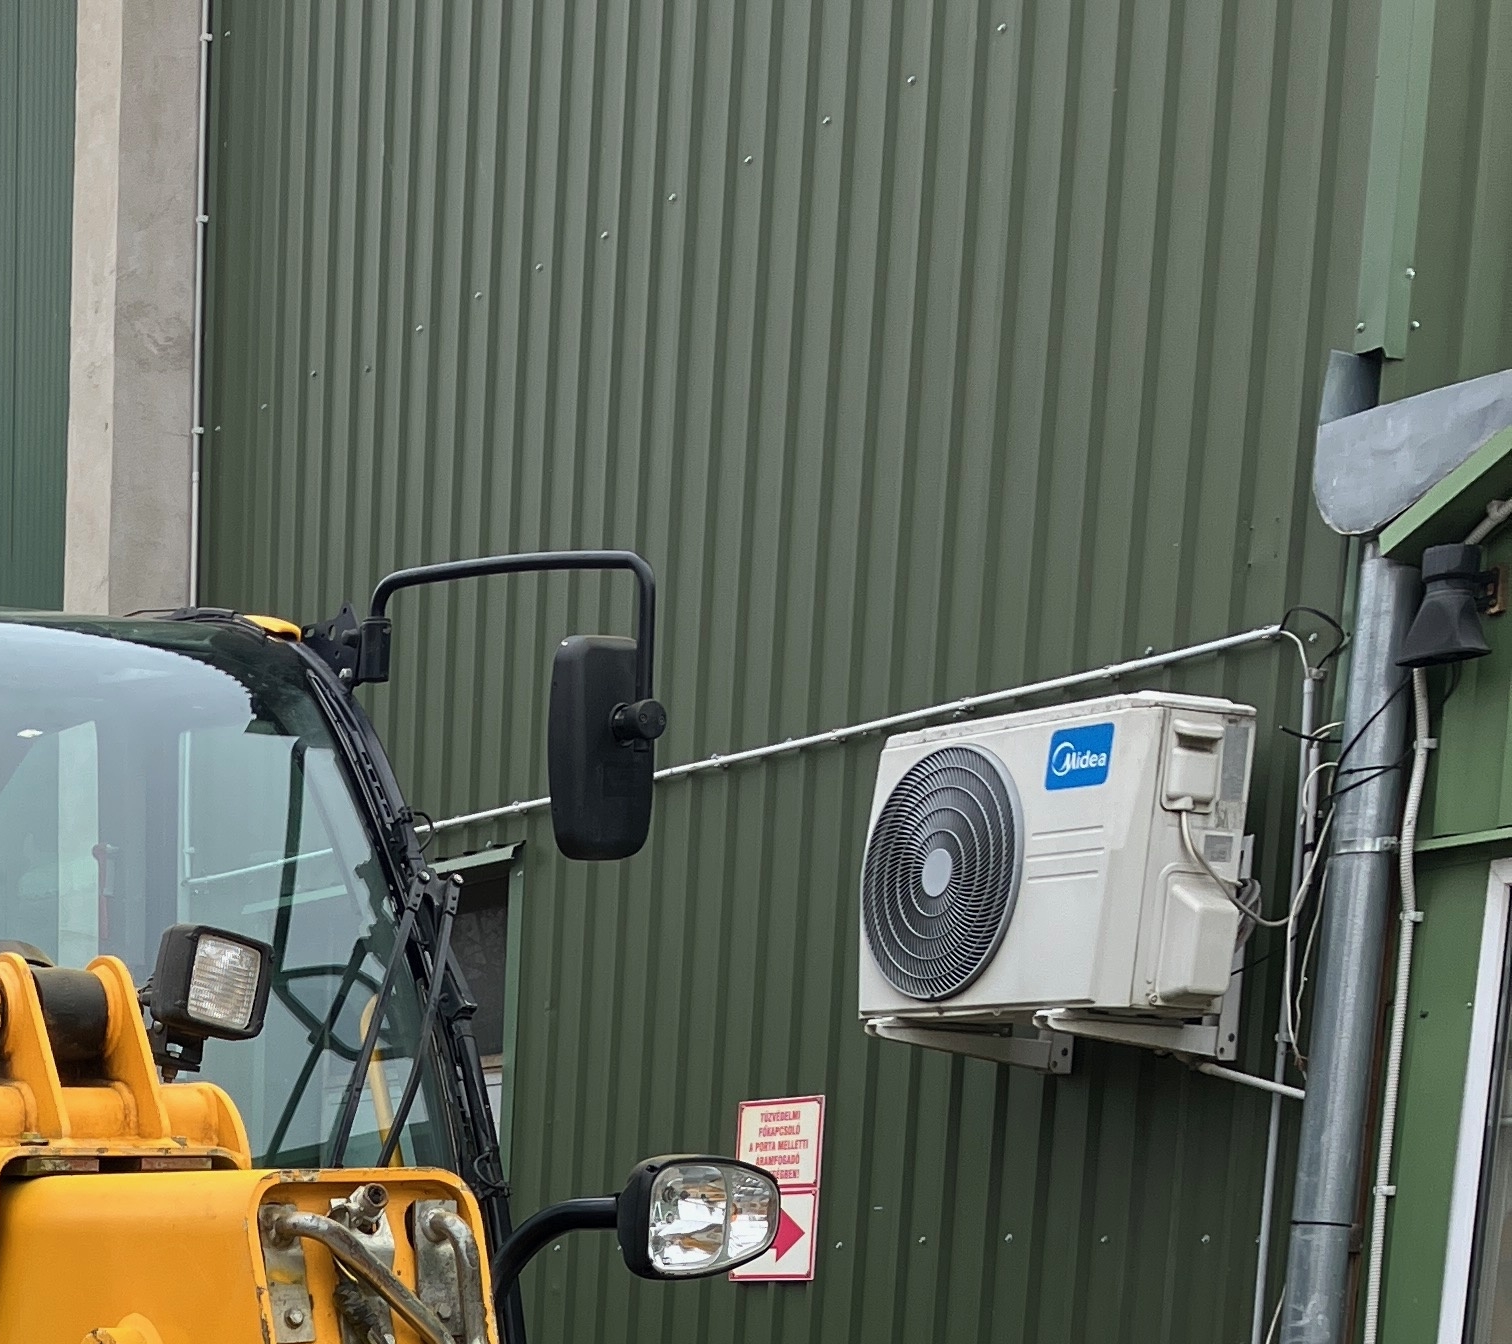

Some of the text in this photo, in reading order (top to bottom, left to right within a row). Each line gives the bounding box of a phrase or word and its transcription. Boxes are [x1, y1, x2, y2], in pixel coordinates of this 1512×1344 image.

[1051, 741, 1107, 776] Midea
[749, 1139, 808, 1152] A PORTA MELLETTI
